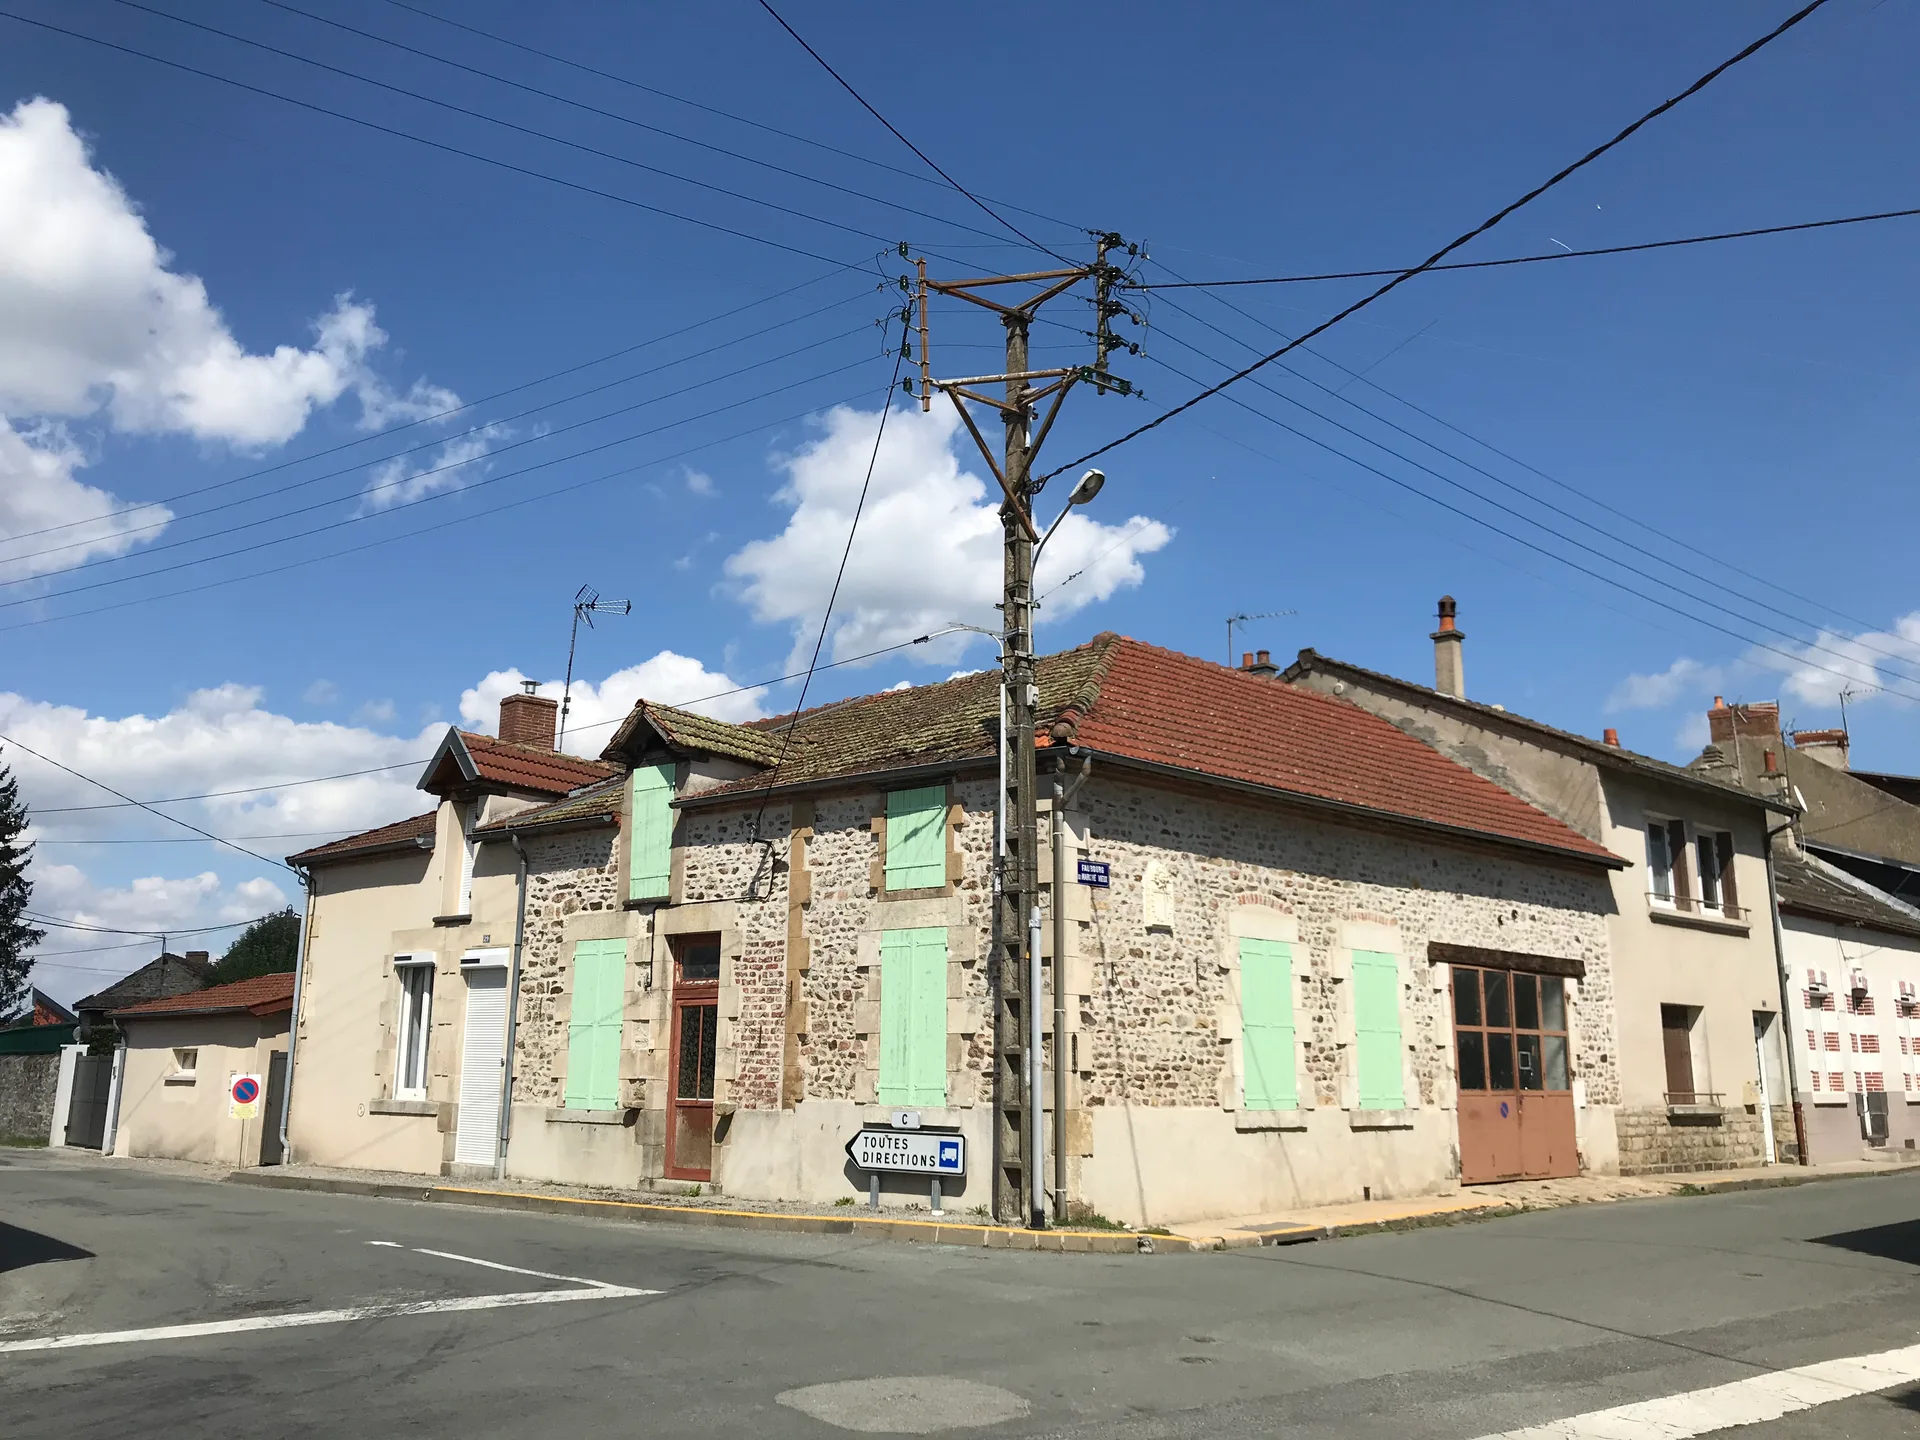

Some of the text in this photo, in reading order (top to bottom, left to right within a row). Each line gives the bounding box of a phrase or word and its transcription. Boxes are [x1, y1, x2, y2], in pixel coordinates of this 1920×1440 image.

[901, 1113, 908, 1125] C
[864, 1136, 908, 1150] TOUTES
[862, 1151, 936, 1167] DIRECTIONS
